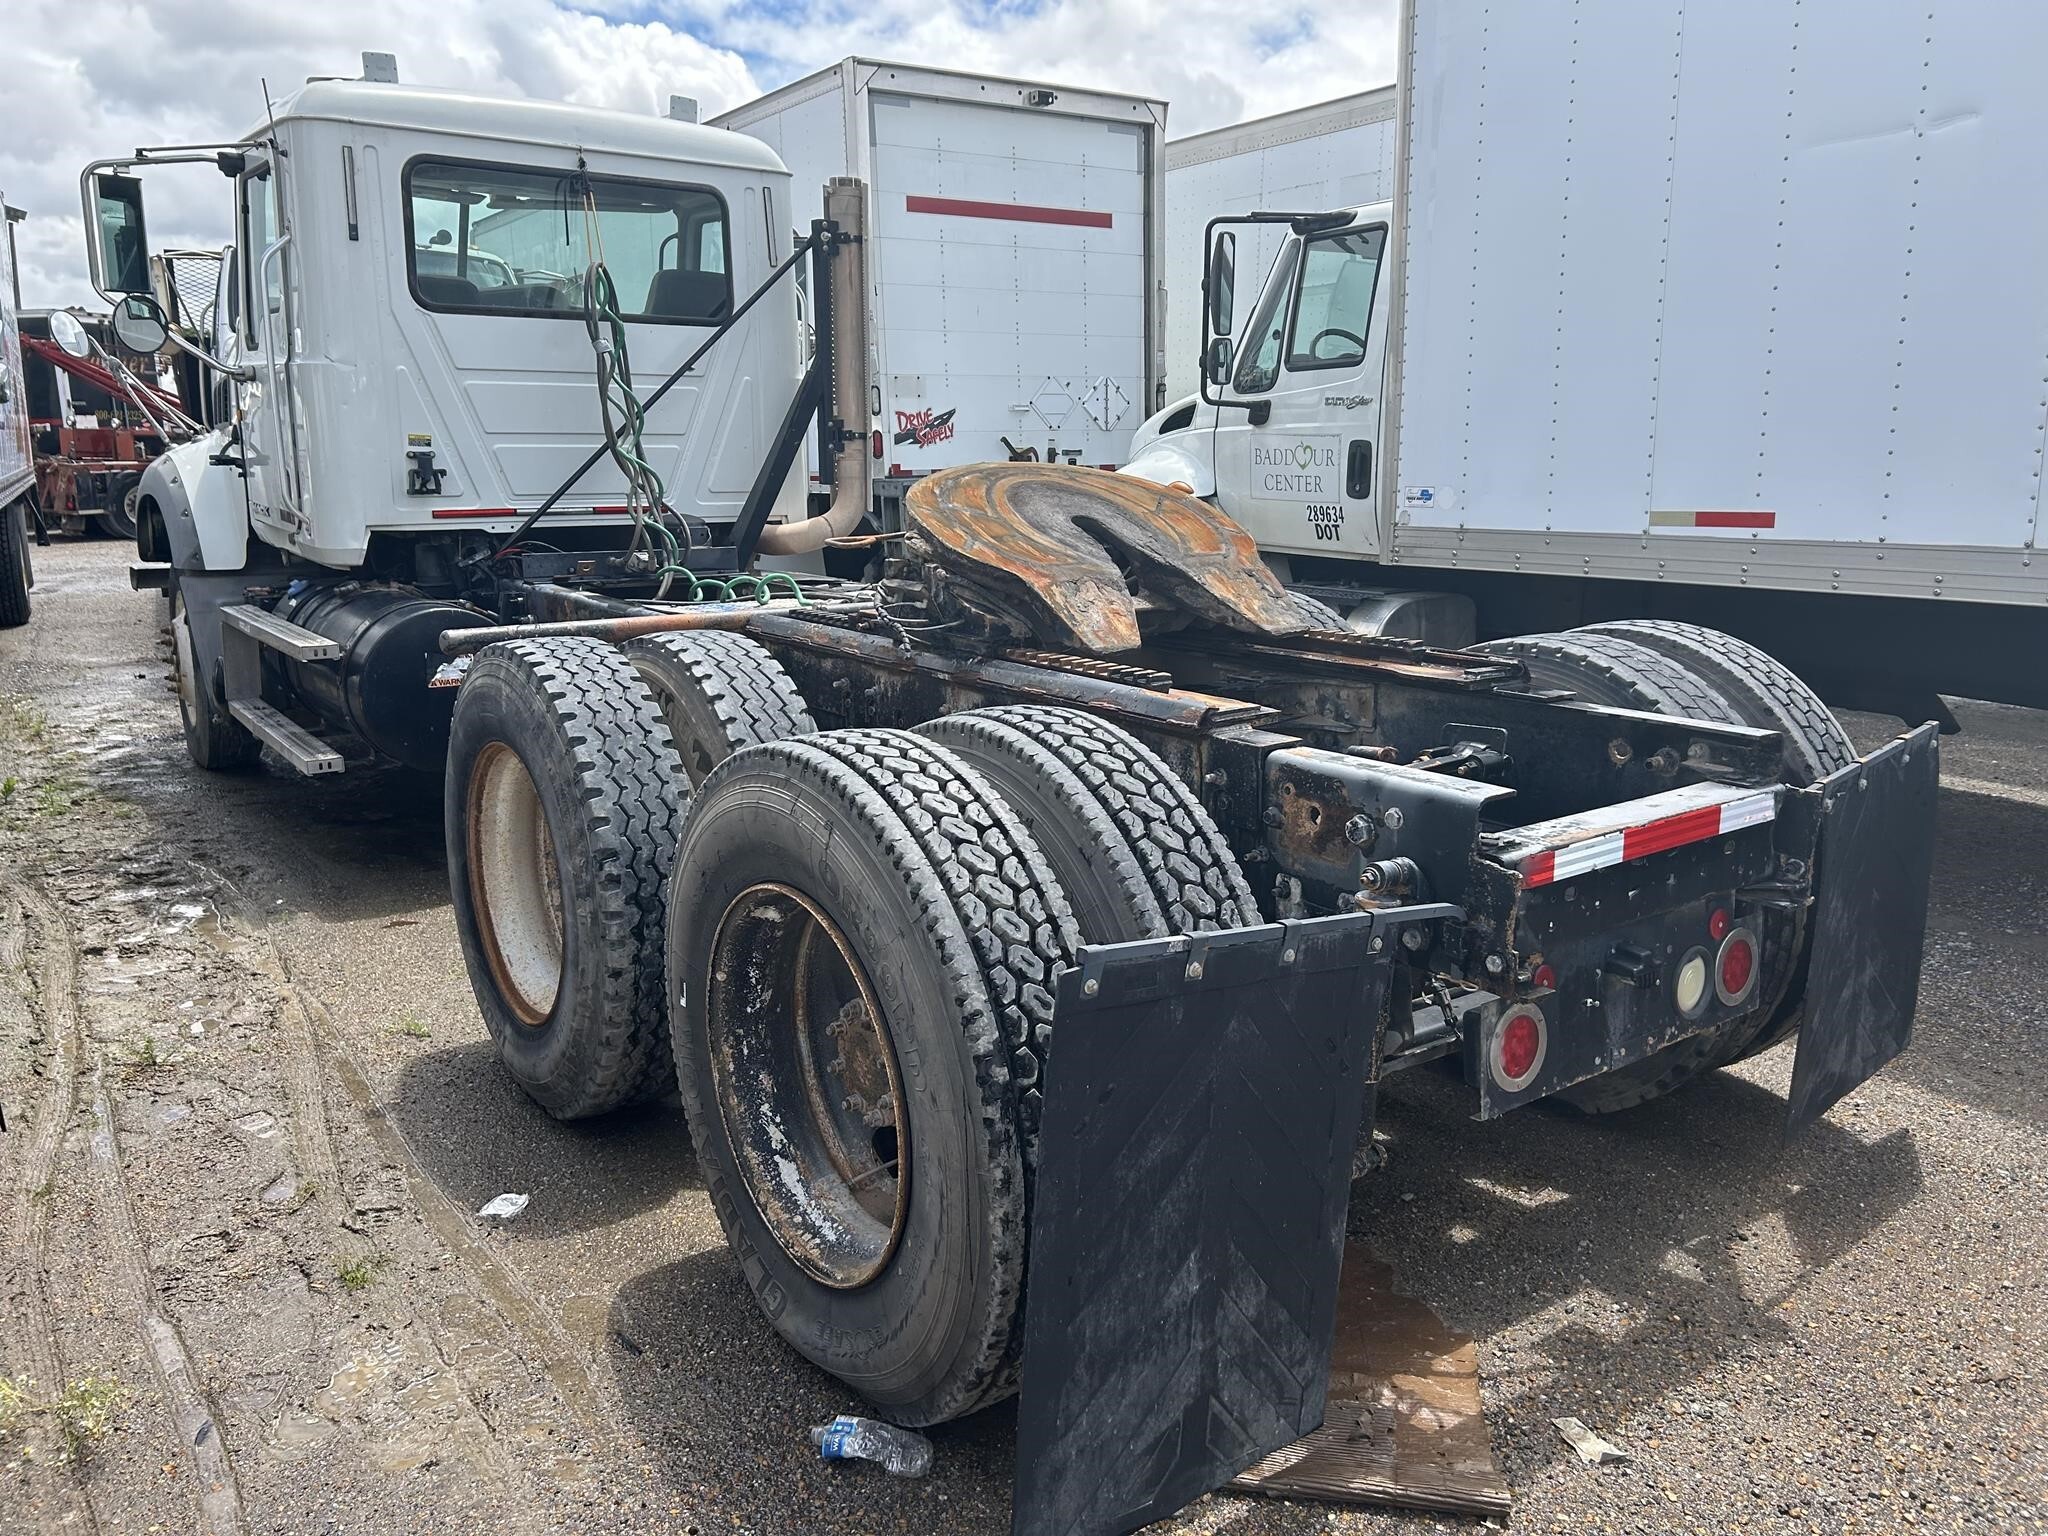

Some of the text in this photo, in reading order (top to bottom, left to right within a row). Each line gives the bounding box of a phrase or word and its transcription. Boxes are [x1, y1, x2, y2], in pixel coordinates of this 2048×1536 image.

[895, 408, 934, 433] DRIVE
[916, 423, 954, 449] SAFELY
[1264, 473, 1323, 493] CENTER
[1306, 505, 1344, 523] 289634
[1315, 523, 1340, 541] DOT
